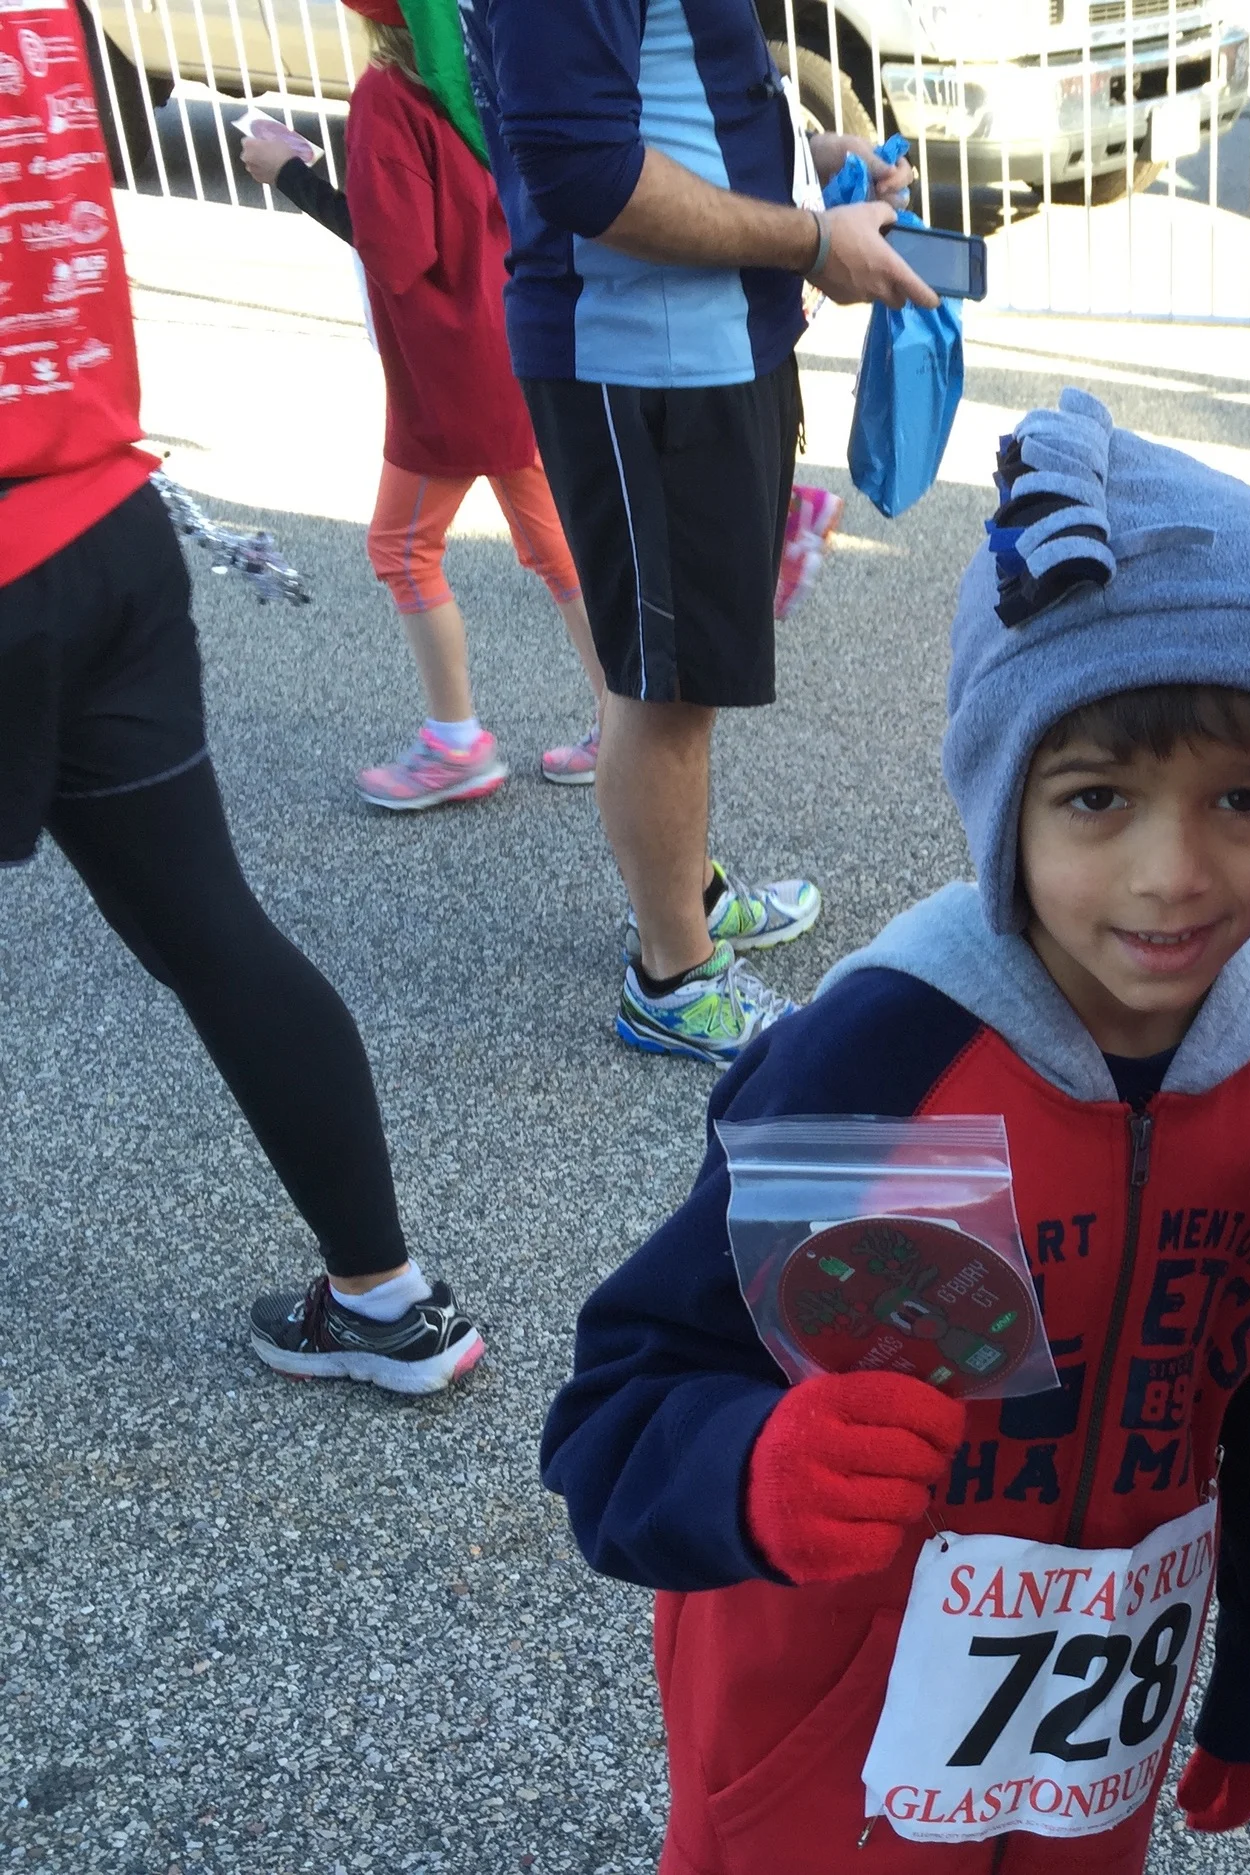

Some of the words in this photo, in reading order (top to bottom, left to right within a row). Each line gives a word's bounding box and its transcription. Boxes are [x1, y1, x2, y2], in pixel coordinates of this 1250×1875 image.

[937, 1259, 990, 1304] G'BURY
[971, 1285, 1000, 1309] CT
[856, 1336, 904, 1370] ANTA'S
[1141, 1373, 1196, 1423] 89
[942, 1564, 1150, 1621] SANTA'S
[1150, 1529, 1213, 1603] RUN
[945, 1602, 1192, 1767] 728
[884, 1748, 1160, 1825] GLASTONBUR
